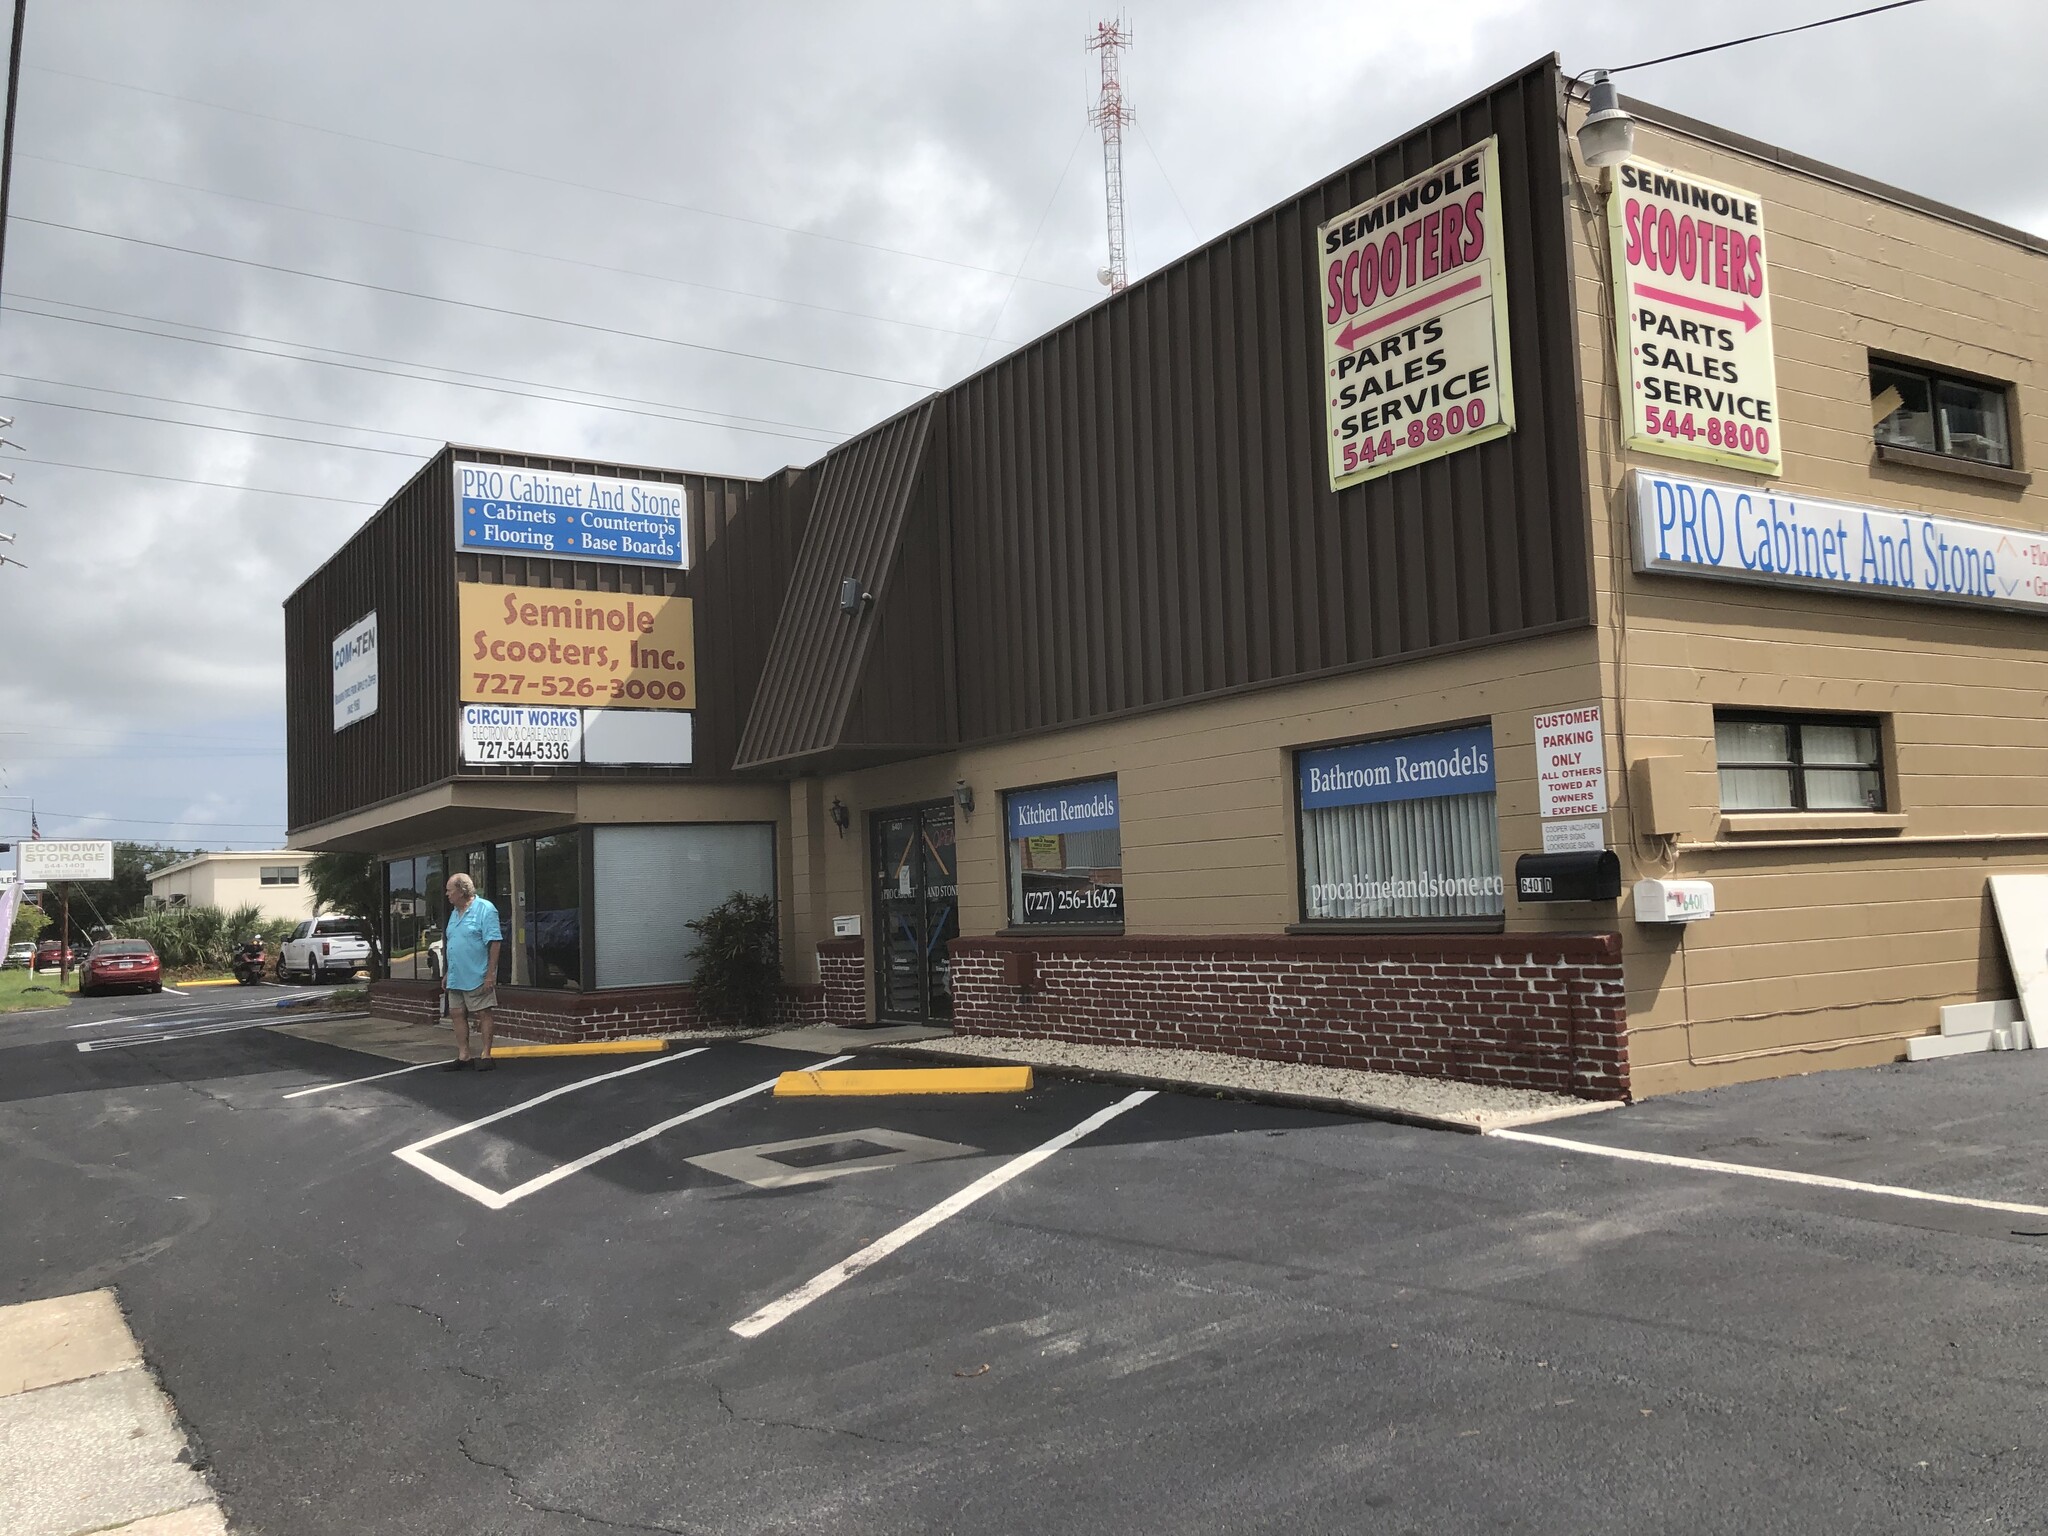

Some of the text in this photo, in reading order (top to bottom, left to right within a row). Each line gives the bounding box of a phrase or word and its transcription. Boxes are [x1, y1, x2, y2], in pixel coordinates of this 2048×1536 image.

[1326, 158, 1480, 255] SEMINOLE
[1620, 164, 1758, 226] SEMINOLE
[1327, 191, 1484, 326] SCOOTERS
[1625, 197, 1763, 299] SCOOTERS
[1639, 308, 1735, 352] PARTS
[1338, 318, 1443, 381] PARTS
[1642, 342, 1738, 384] SALES
[1340, 349, 1447, 410] SALES
[1341, 365, 1490, 440] SERVICE
[1643, 376, 1772, 423] SERVICE
[1343, 398, 1486, 472] 544-8800
[1645, 405, 1770, 454] 544-8800
[463, 469, 681, 517] PRO Cabinet And Stone
[483, 502, 676, 537] Cabinets Countertops
[483, 524, 674, 556] Flooring Base Boards
[1654, 480, 1996, 598] PRO Cabinet And Stone
[503, 592, 655, 634] Seminole
[473, 630, 685, 672] Scooters, Inc.
[473, 672, 686, 701] 727-526-3000
[467, 708, 578, 727] CIRCUIT WORKS
[472, 725, 573, 742] ELECTRONIC & CABLE ASSEMBLY
[1535, 709, 1599, 729] CUSTOMER
[478, 741, 569, 760] 727-544-5336
[1543, 730, 1594, 748] PARKING
[1310, 745, 1489, 793] Bathroom Remodels
[1541, 766, 1602, 780] ALL OTHERS
[1552, 752, 1582, 768] ONLY
[1548, 779, 1598, 792] TOWED AT
[1552, 792, 1594, 804] OWNERS
[1018, 794, 1114, 826] Kitchen Remodels
[1552, 803, 1598, 815] EXPENCE
[1545, 824, 1568, 833] COOPER
[1546, 832, 1586, 842] COOPER SIGNS
[25, 843, 105, 853] ECONOMY
[25, 853, 104, 863] STORAGE
[1025, 888, 1118, 916] (727) 256-1642
